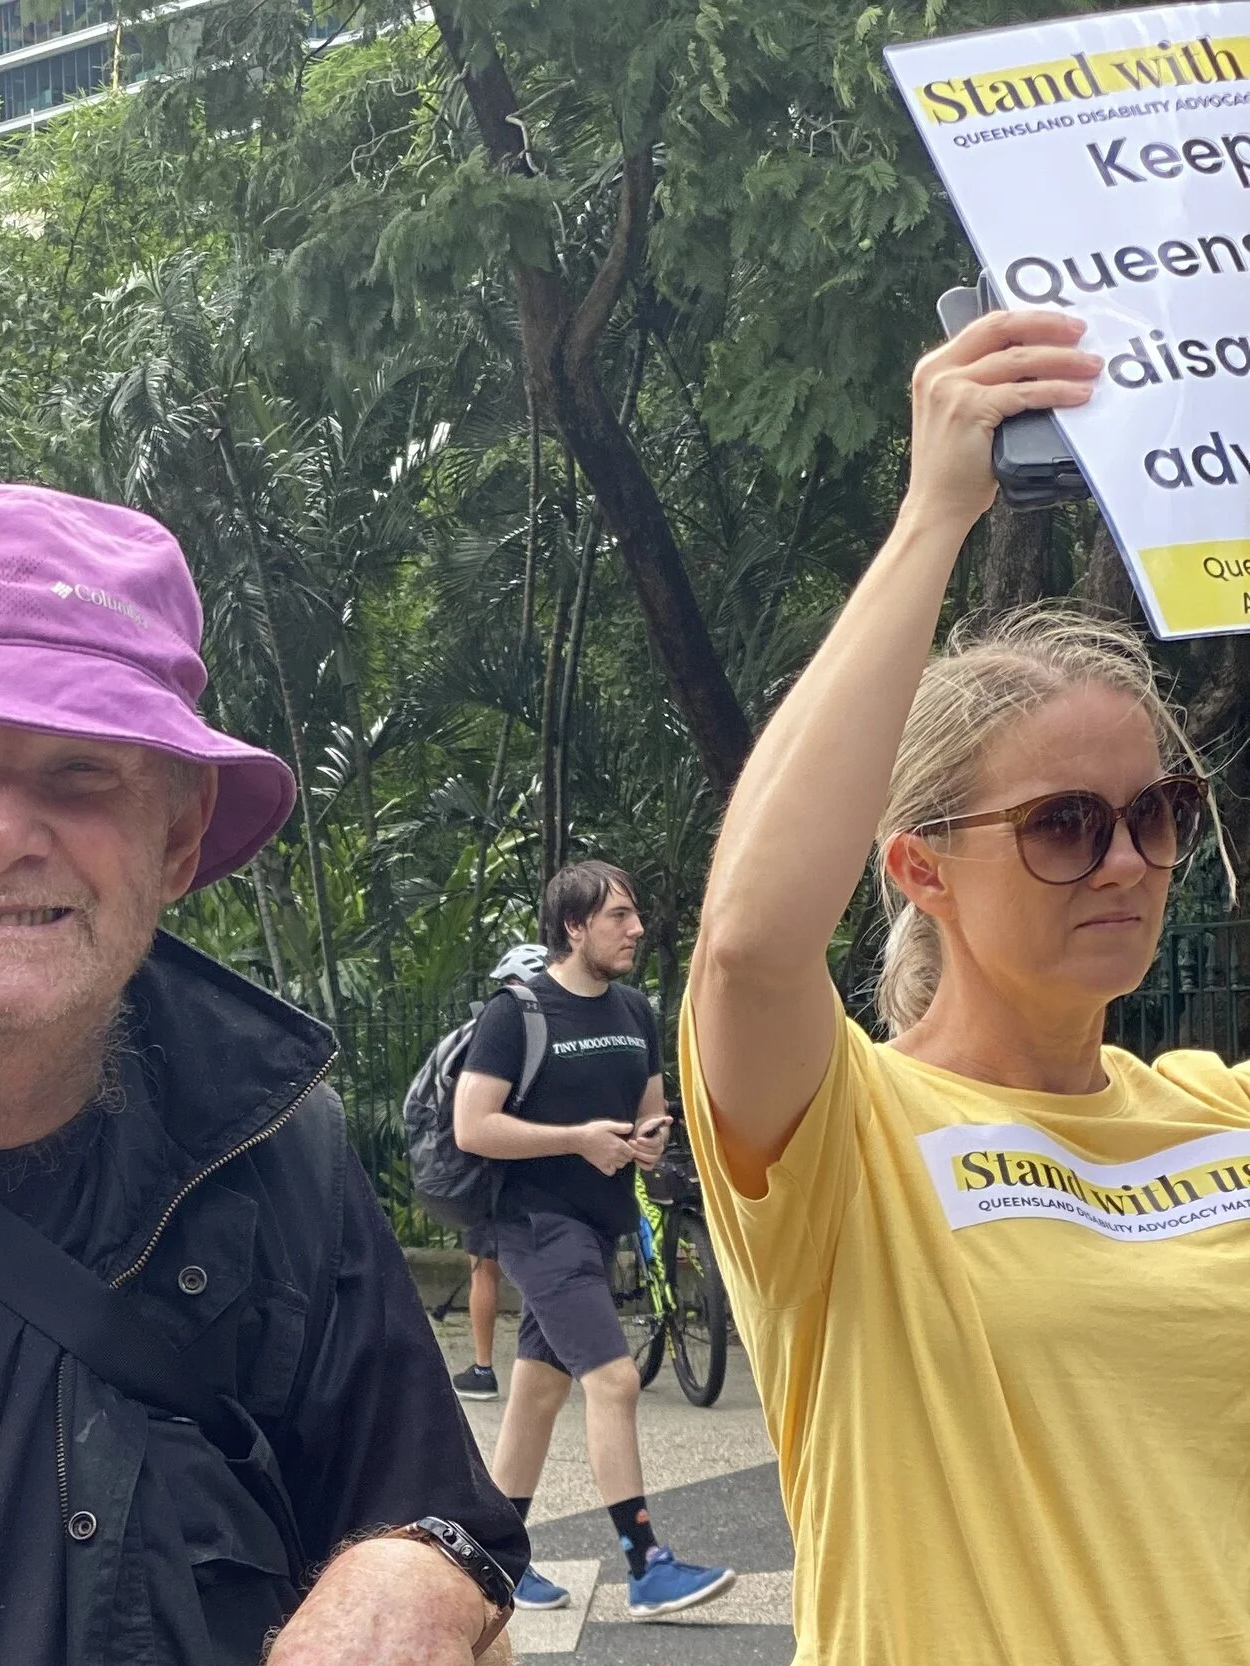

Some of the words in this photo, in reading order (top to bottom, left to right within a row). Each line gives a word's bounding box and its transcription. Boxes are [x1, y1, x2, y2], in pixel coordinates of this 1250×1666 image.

[922, 50, 1111, 127] Stand
[1110, 34, 1250, 92] with
[952, 114, 1075, 149] QUEENSLAND
[1076, 100, 1171, 126] DISABILITY
[1085, 133, 1250, 188] Keep
[1107, 328, 1250, 390] disa
[552, 1041, 578, 1055] TINY
[960, 1150, 1090, 1205] Stand
[1090, 1174, 1204, 1218] with
[978, 1196, 1075, 1213] QUEENSLAND
[1075, 1205, 1135, 1234] DISABILITY
[1137, 1204, 1218, 1234] ADVOCACY
